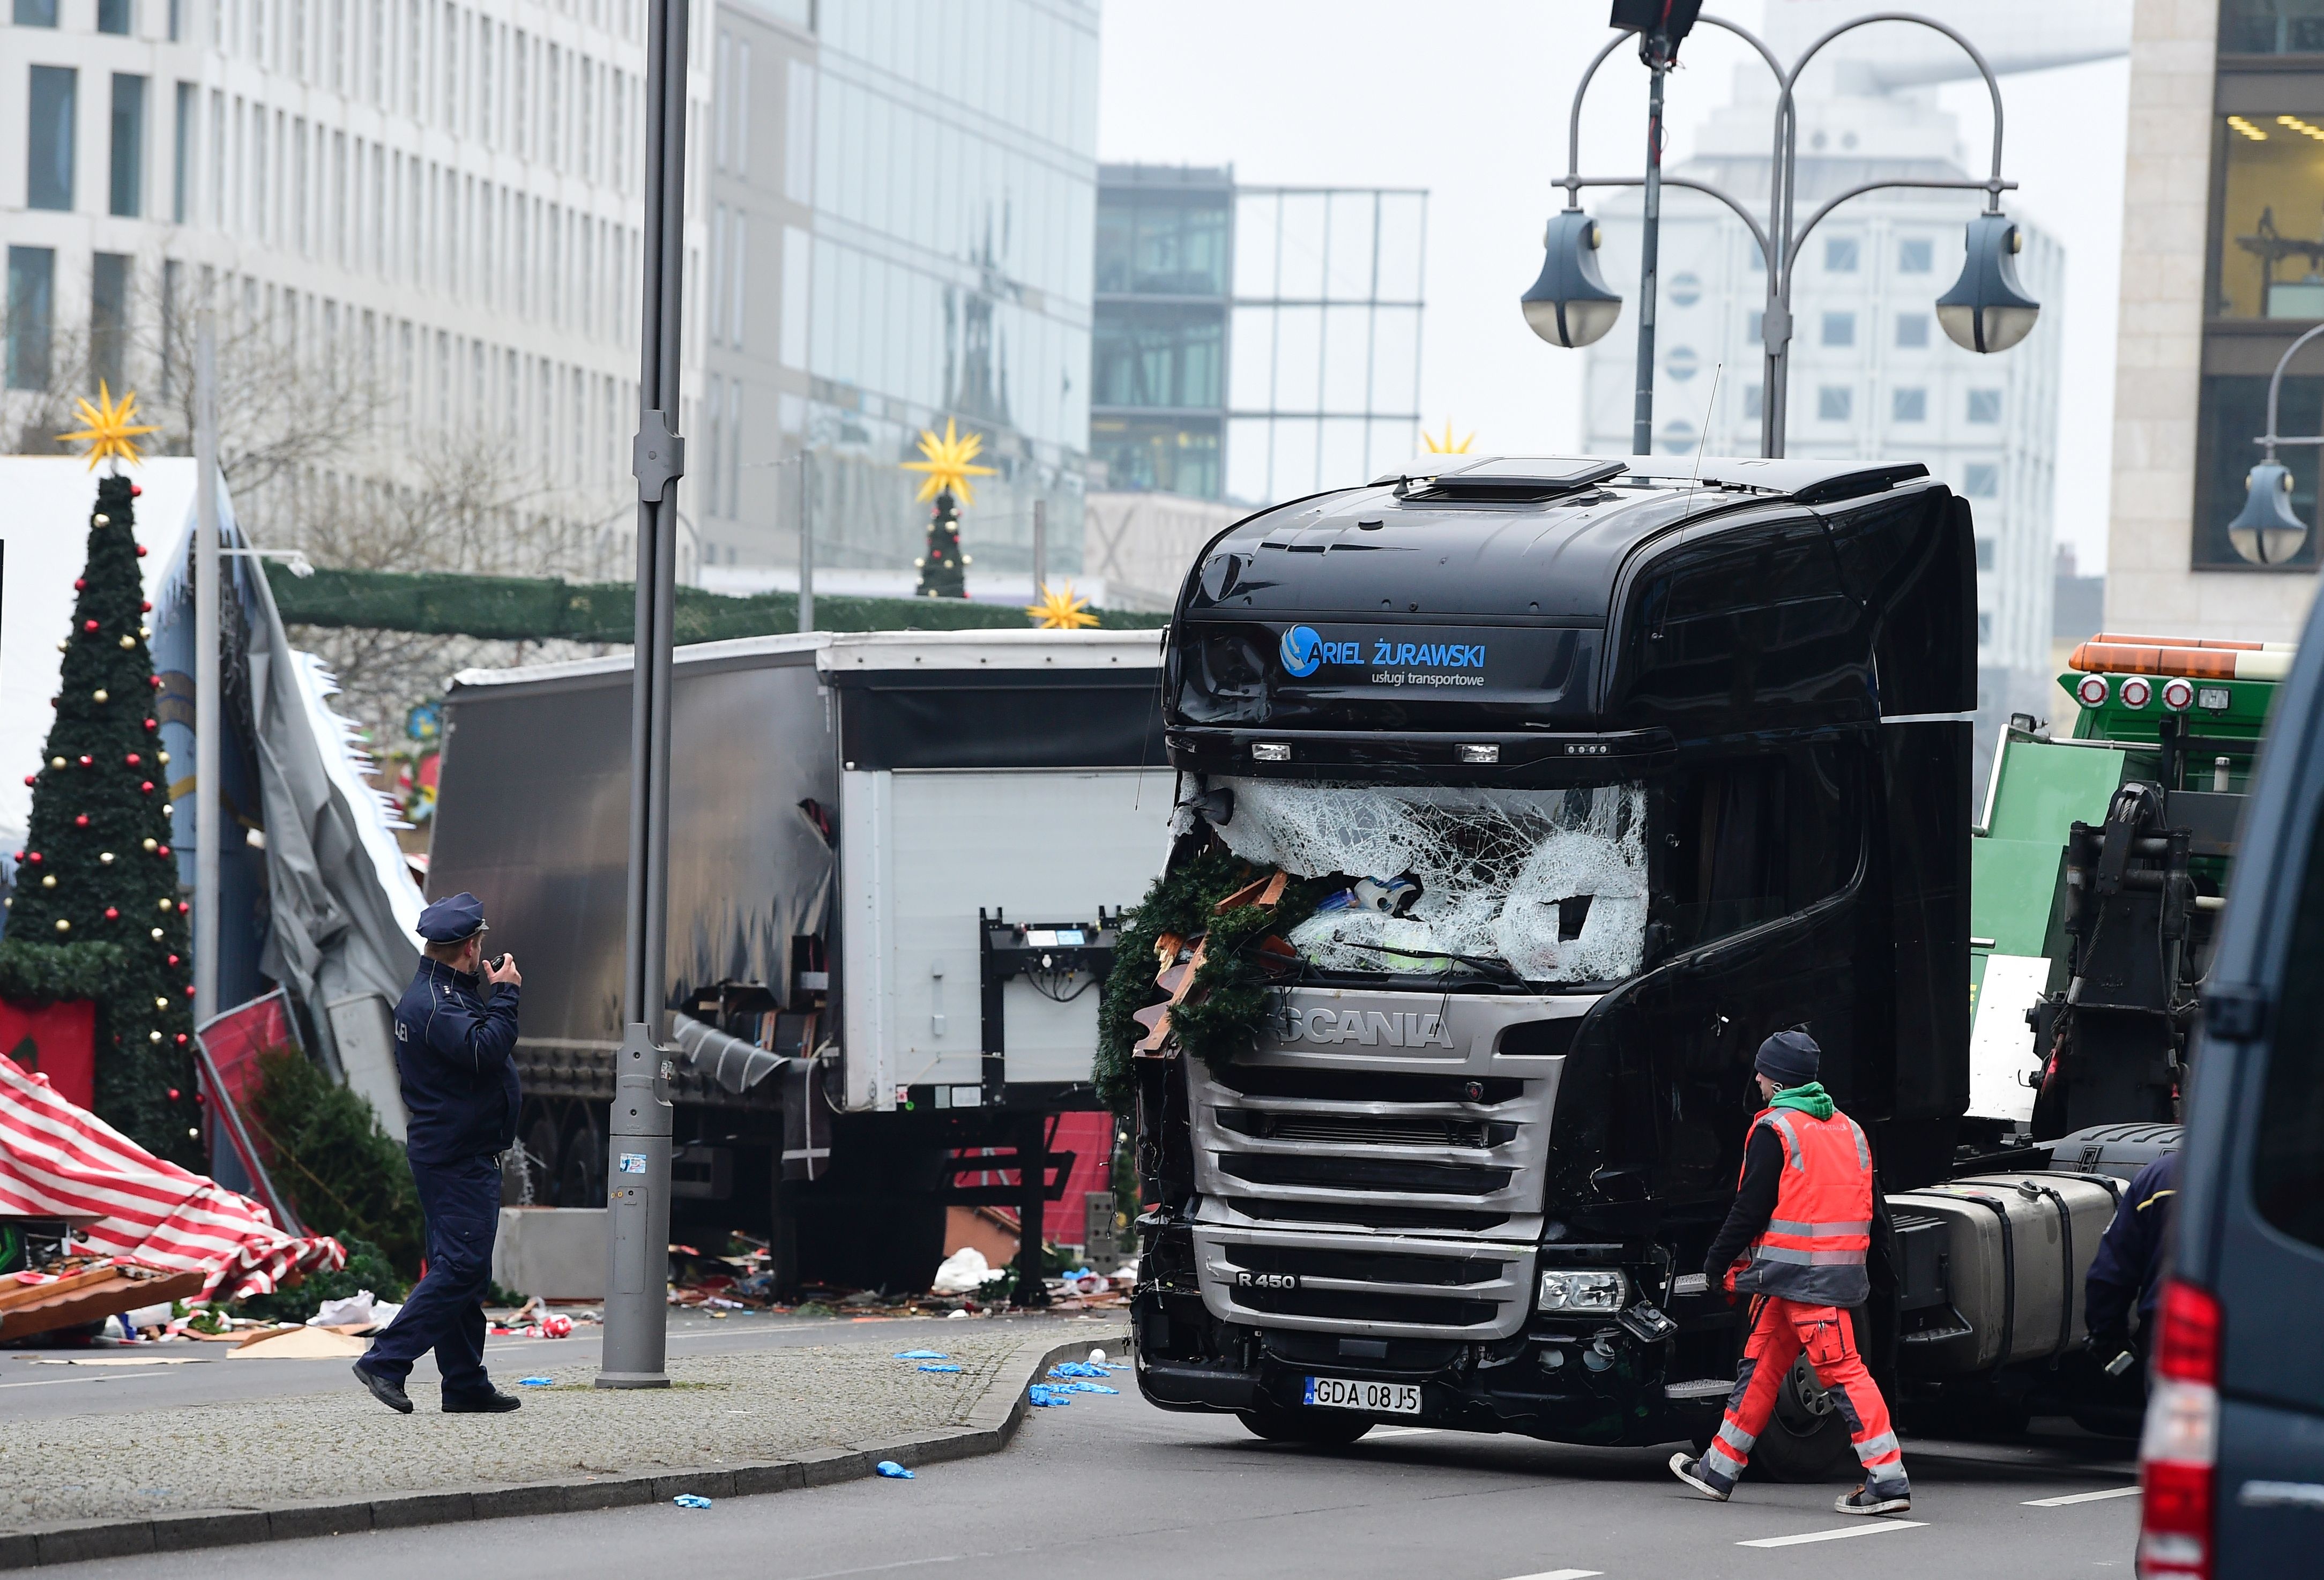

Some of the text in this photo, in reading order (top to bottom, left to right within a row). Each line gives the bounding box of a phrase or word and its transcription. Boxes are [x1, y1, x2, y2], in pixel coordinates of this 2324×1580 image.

[1306, 638, 1485, 668] ARIEL ŻURAWSKI
[1372, 670, 1485, 688] usługi transportowe
[1277, 1006, 1455, 1049] SCANIA
[1239, 1273, 1295, 1289] R 450
[1318, 1380, 1417, 1410] GDA 08J5
